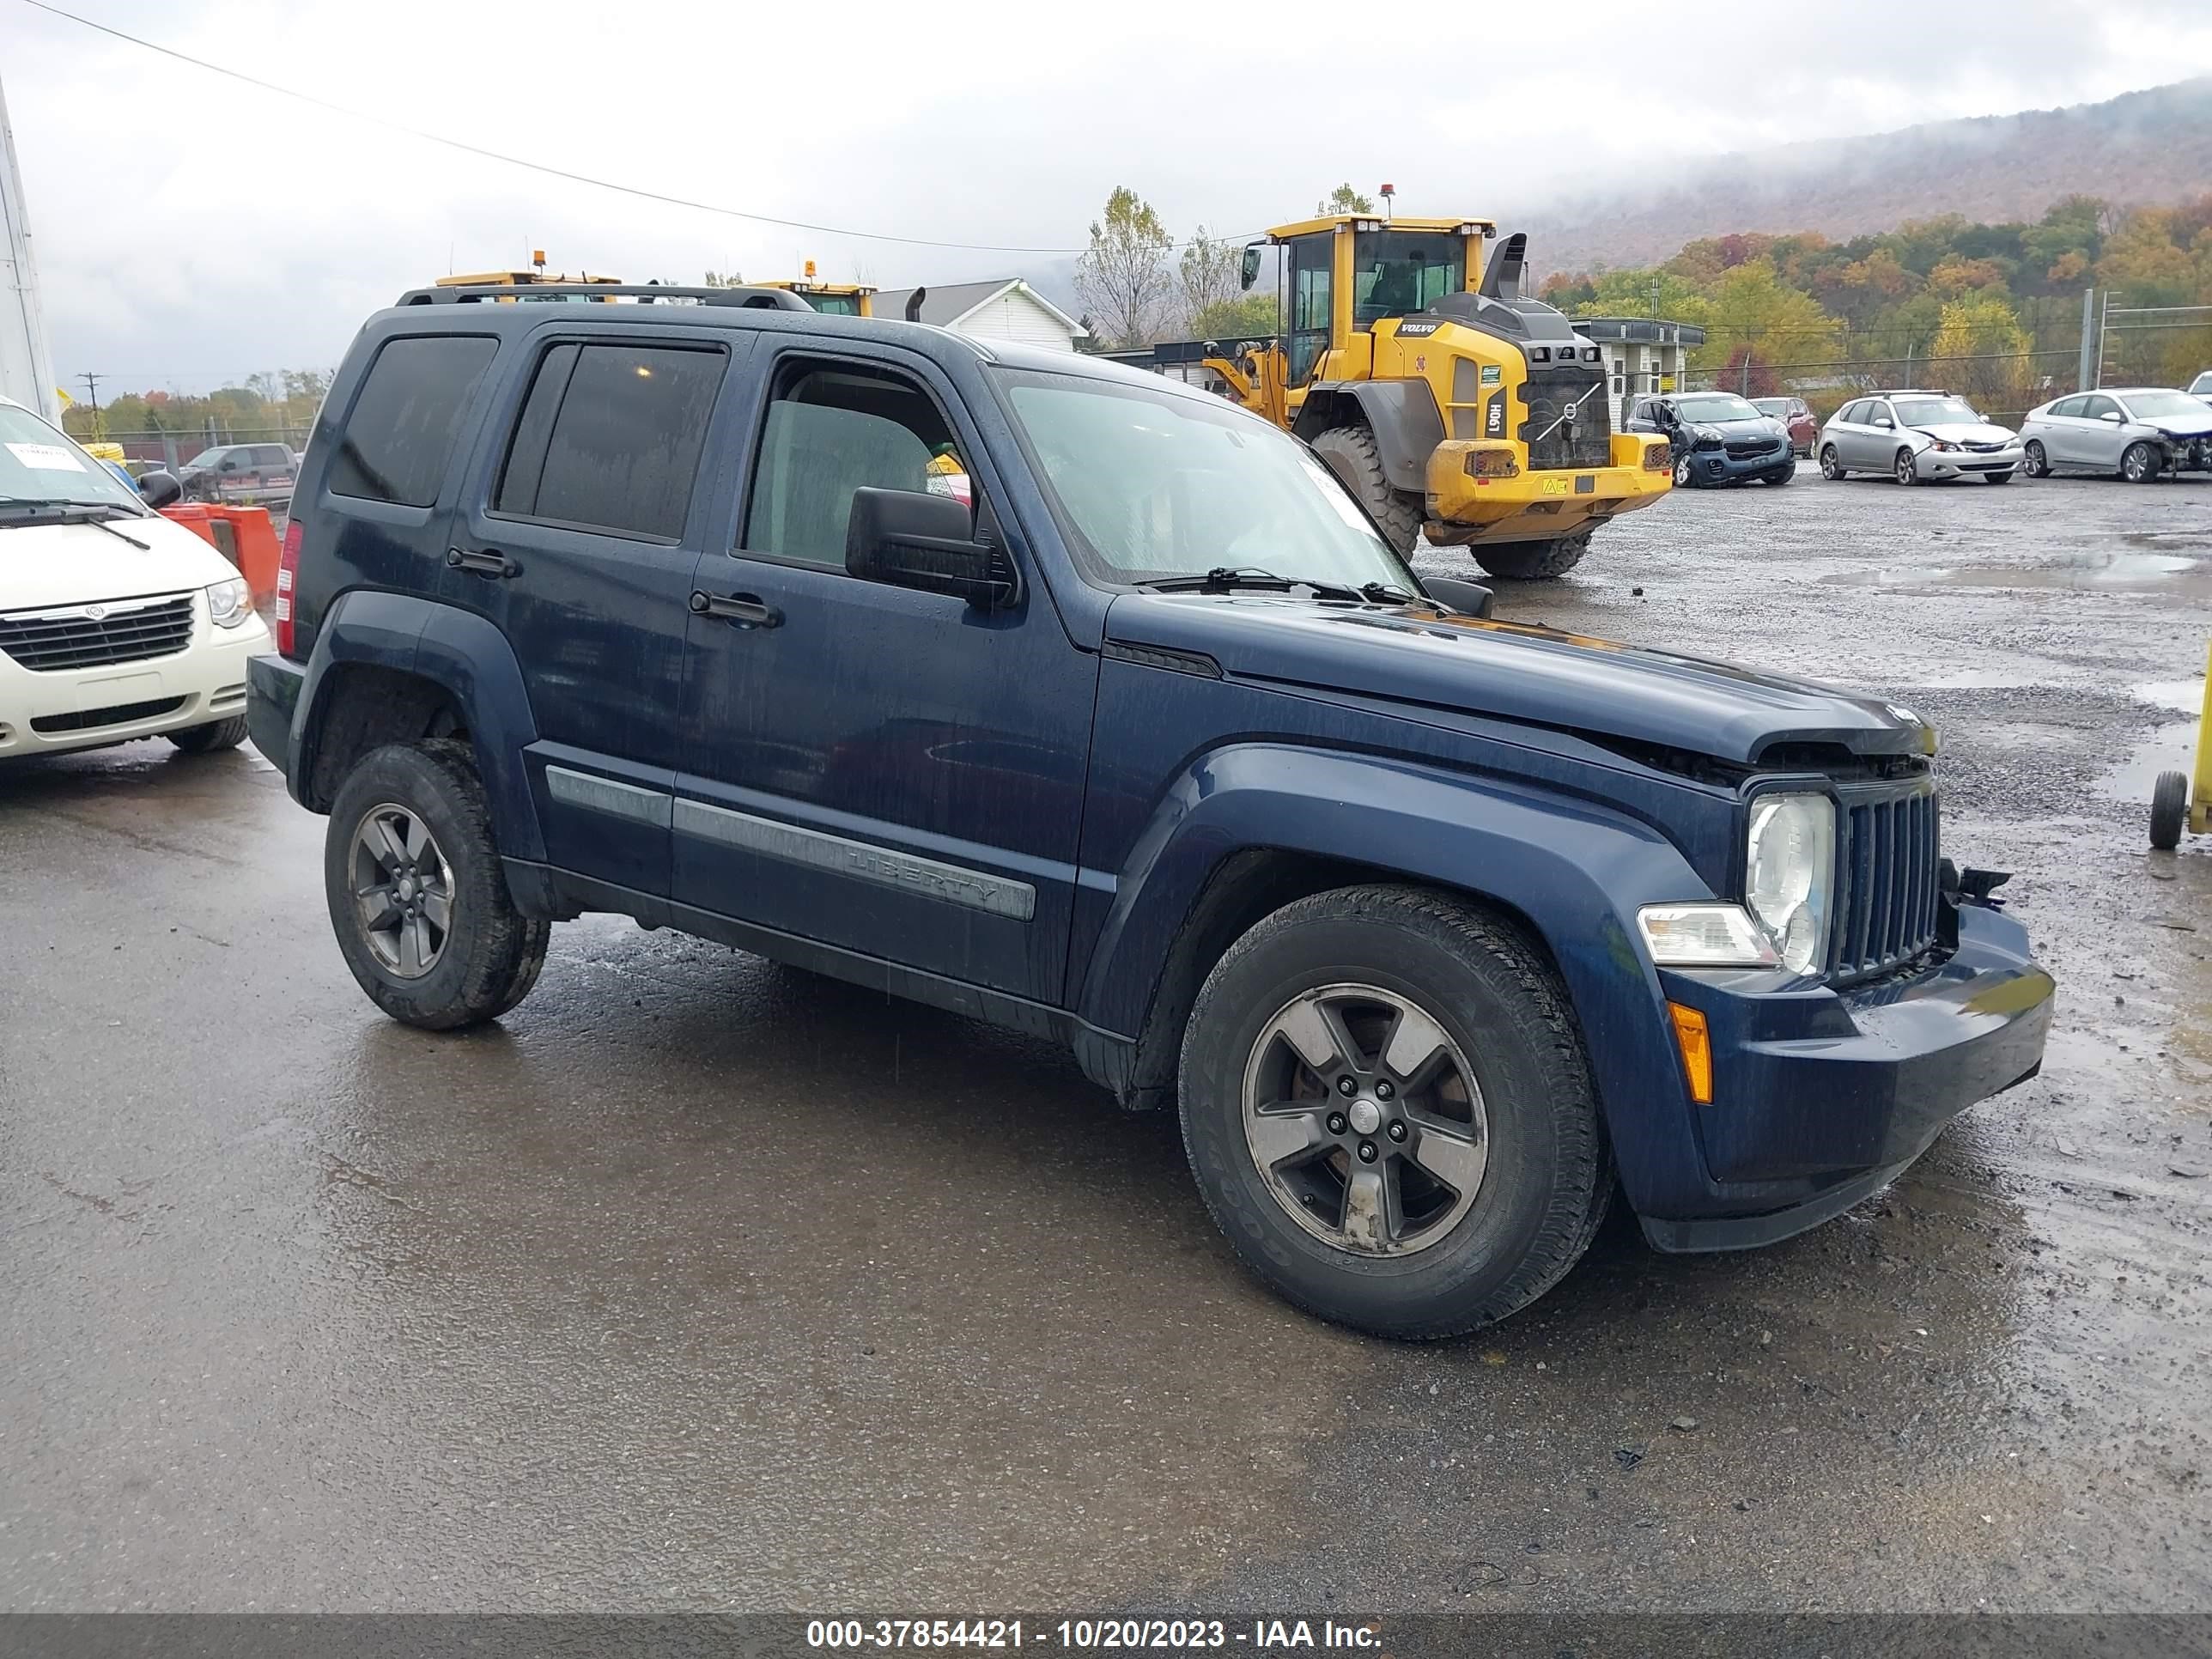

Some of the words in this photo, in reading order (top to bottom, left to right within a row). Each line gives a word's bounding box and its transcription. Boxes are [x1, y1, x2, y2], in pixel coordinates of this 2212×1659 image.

[1401, 324, 1437, 333] VOLVO
[1488, 404, 1502, 432] L90H
[848, 851, 997, 901] LIBERTY
